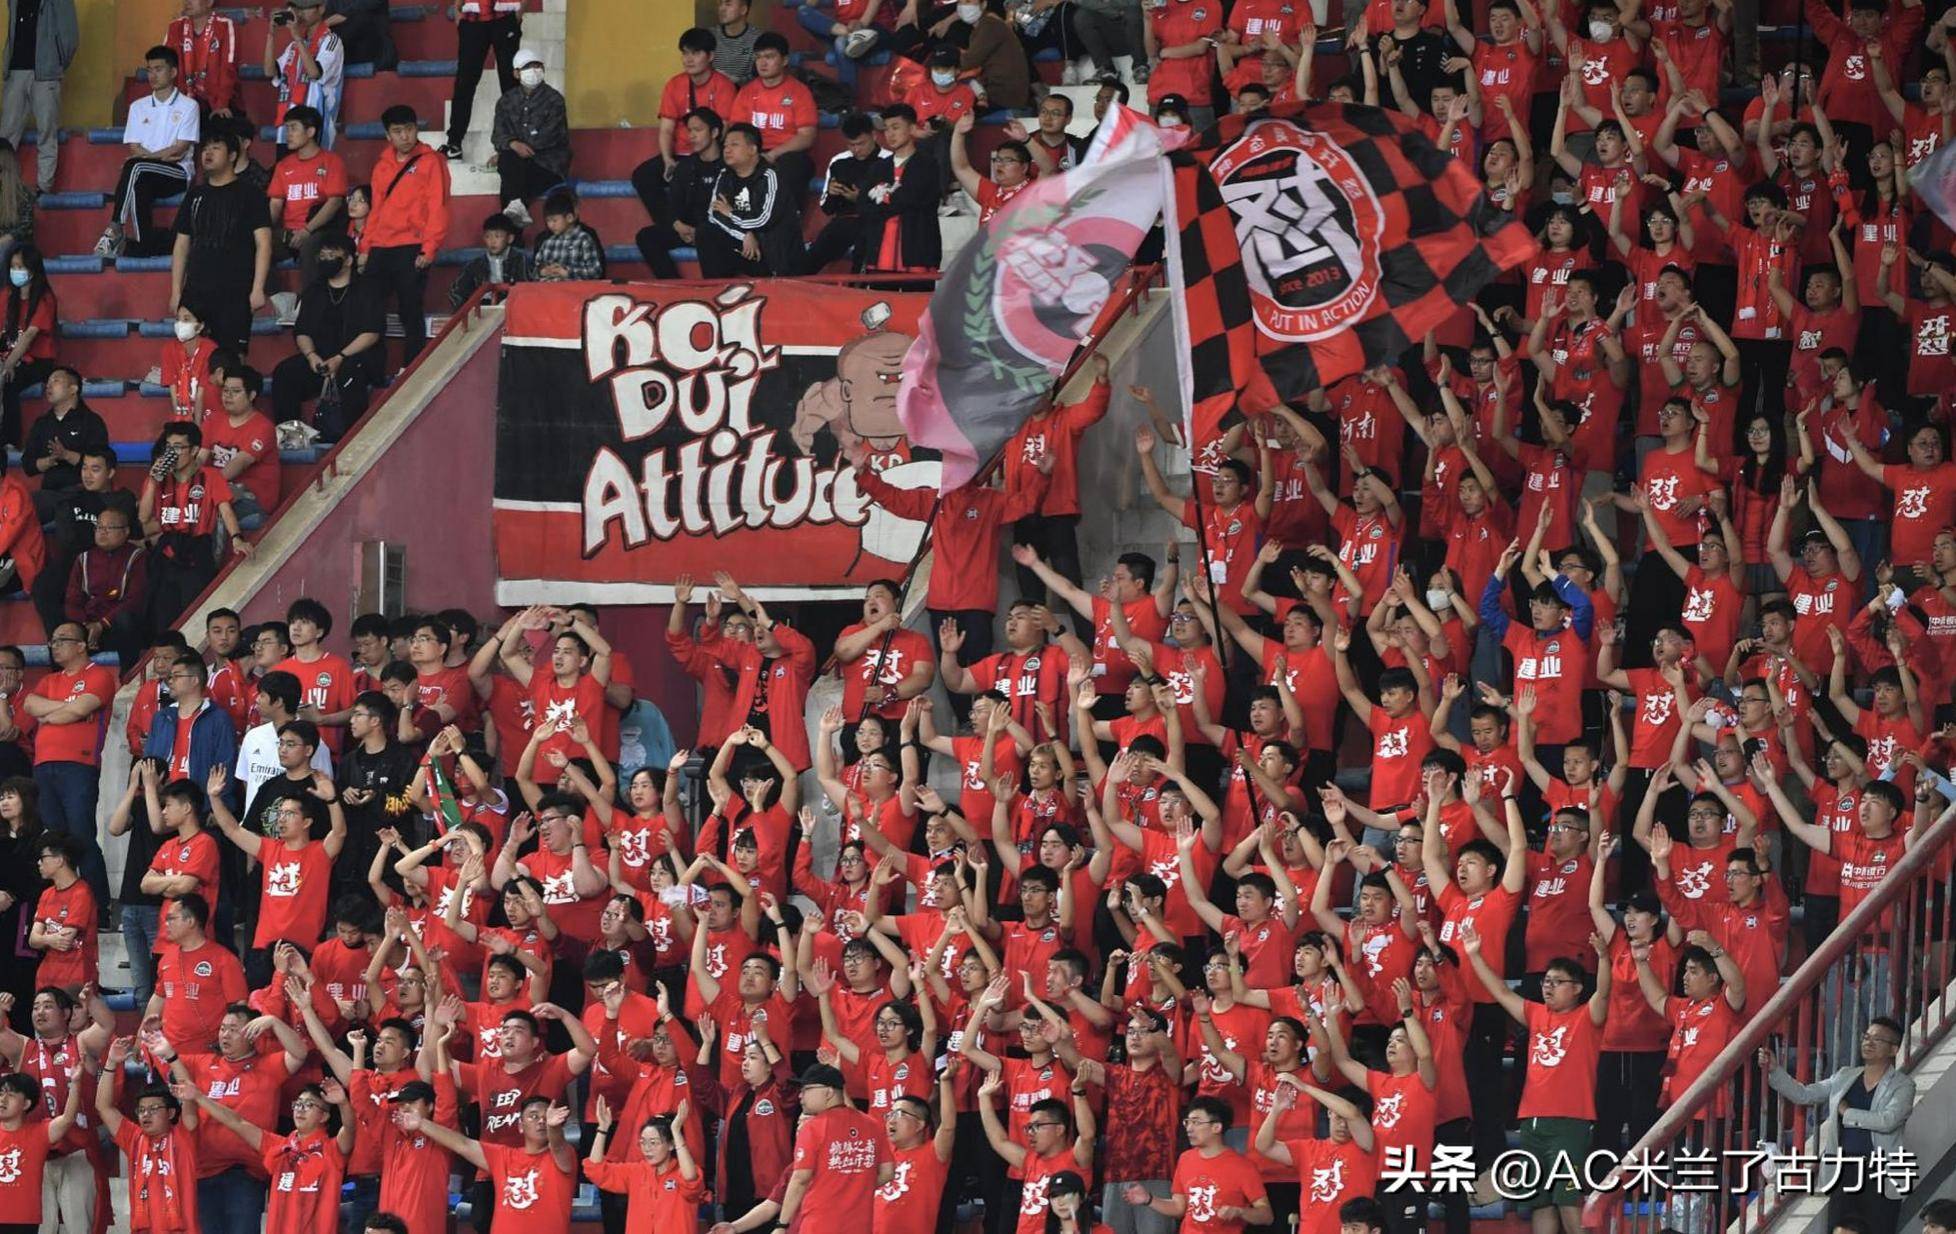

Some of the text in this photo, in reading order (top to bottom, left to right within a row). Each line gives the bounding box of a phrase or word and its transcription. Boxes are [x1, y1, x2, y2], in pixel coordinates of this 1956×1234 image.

[1795, 196, 1811, 210] 业
[1298, 314, 1319, 331] IN
[1320, 281, 1371, 326] ACTION
[1650, 476, 1679, 511] 怼
[1896, 485, 1929, 517] 怼
[161, 504, 202, 524] 建业
[1517, 656, 1562, 679] 建业
[1646, 691, 1672, 721] 怼
[620, 827, 649, 867] 怼
[1533, 1027, 1568, 1067] 怼
[1372, 1092, 1403, 1127] 怼
[503, 1169, 539, 1209] 怼
[1310, 1159, 1345, 1202] 怼
[1188, 1186, 1217, 1222] 怼
